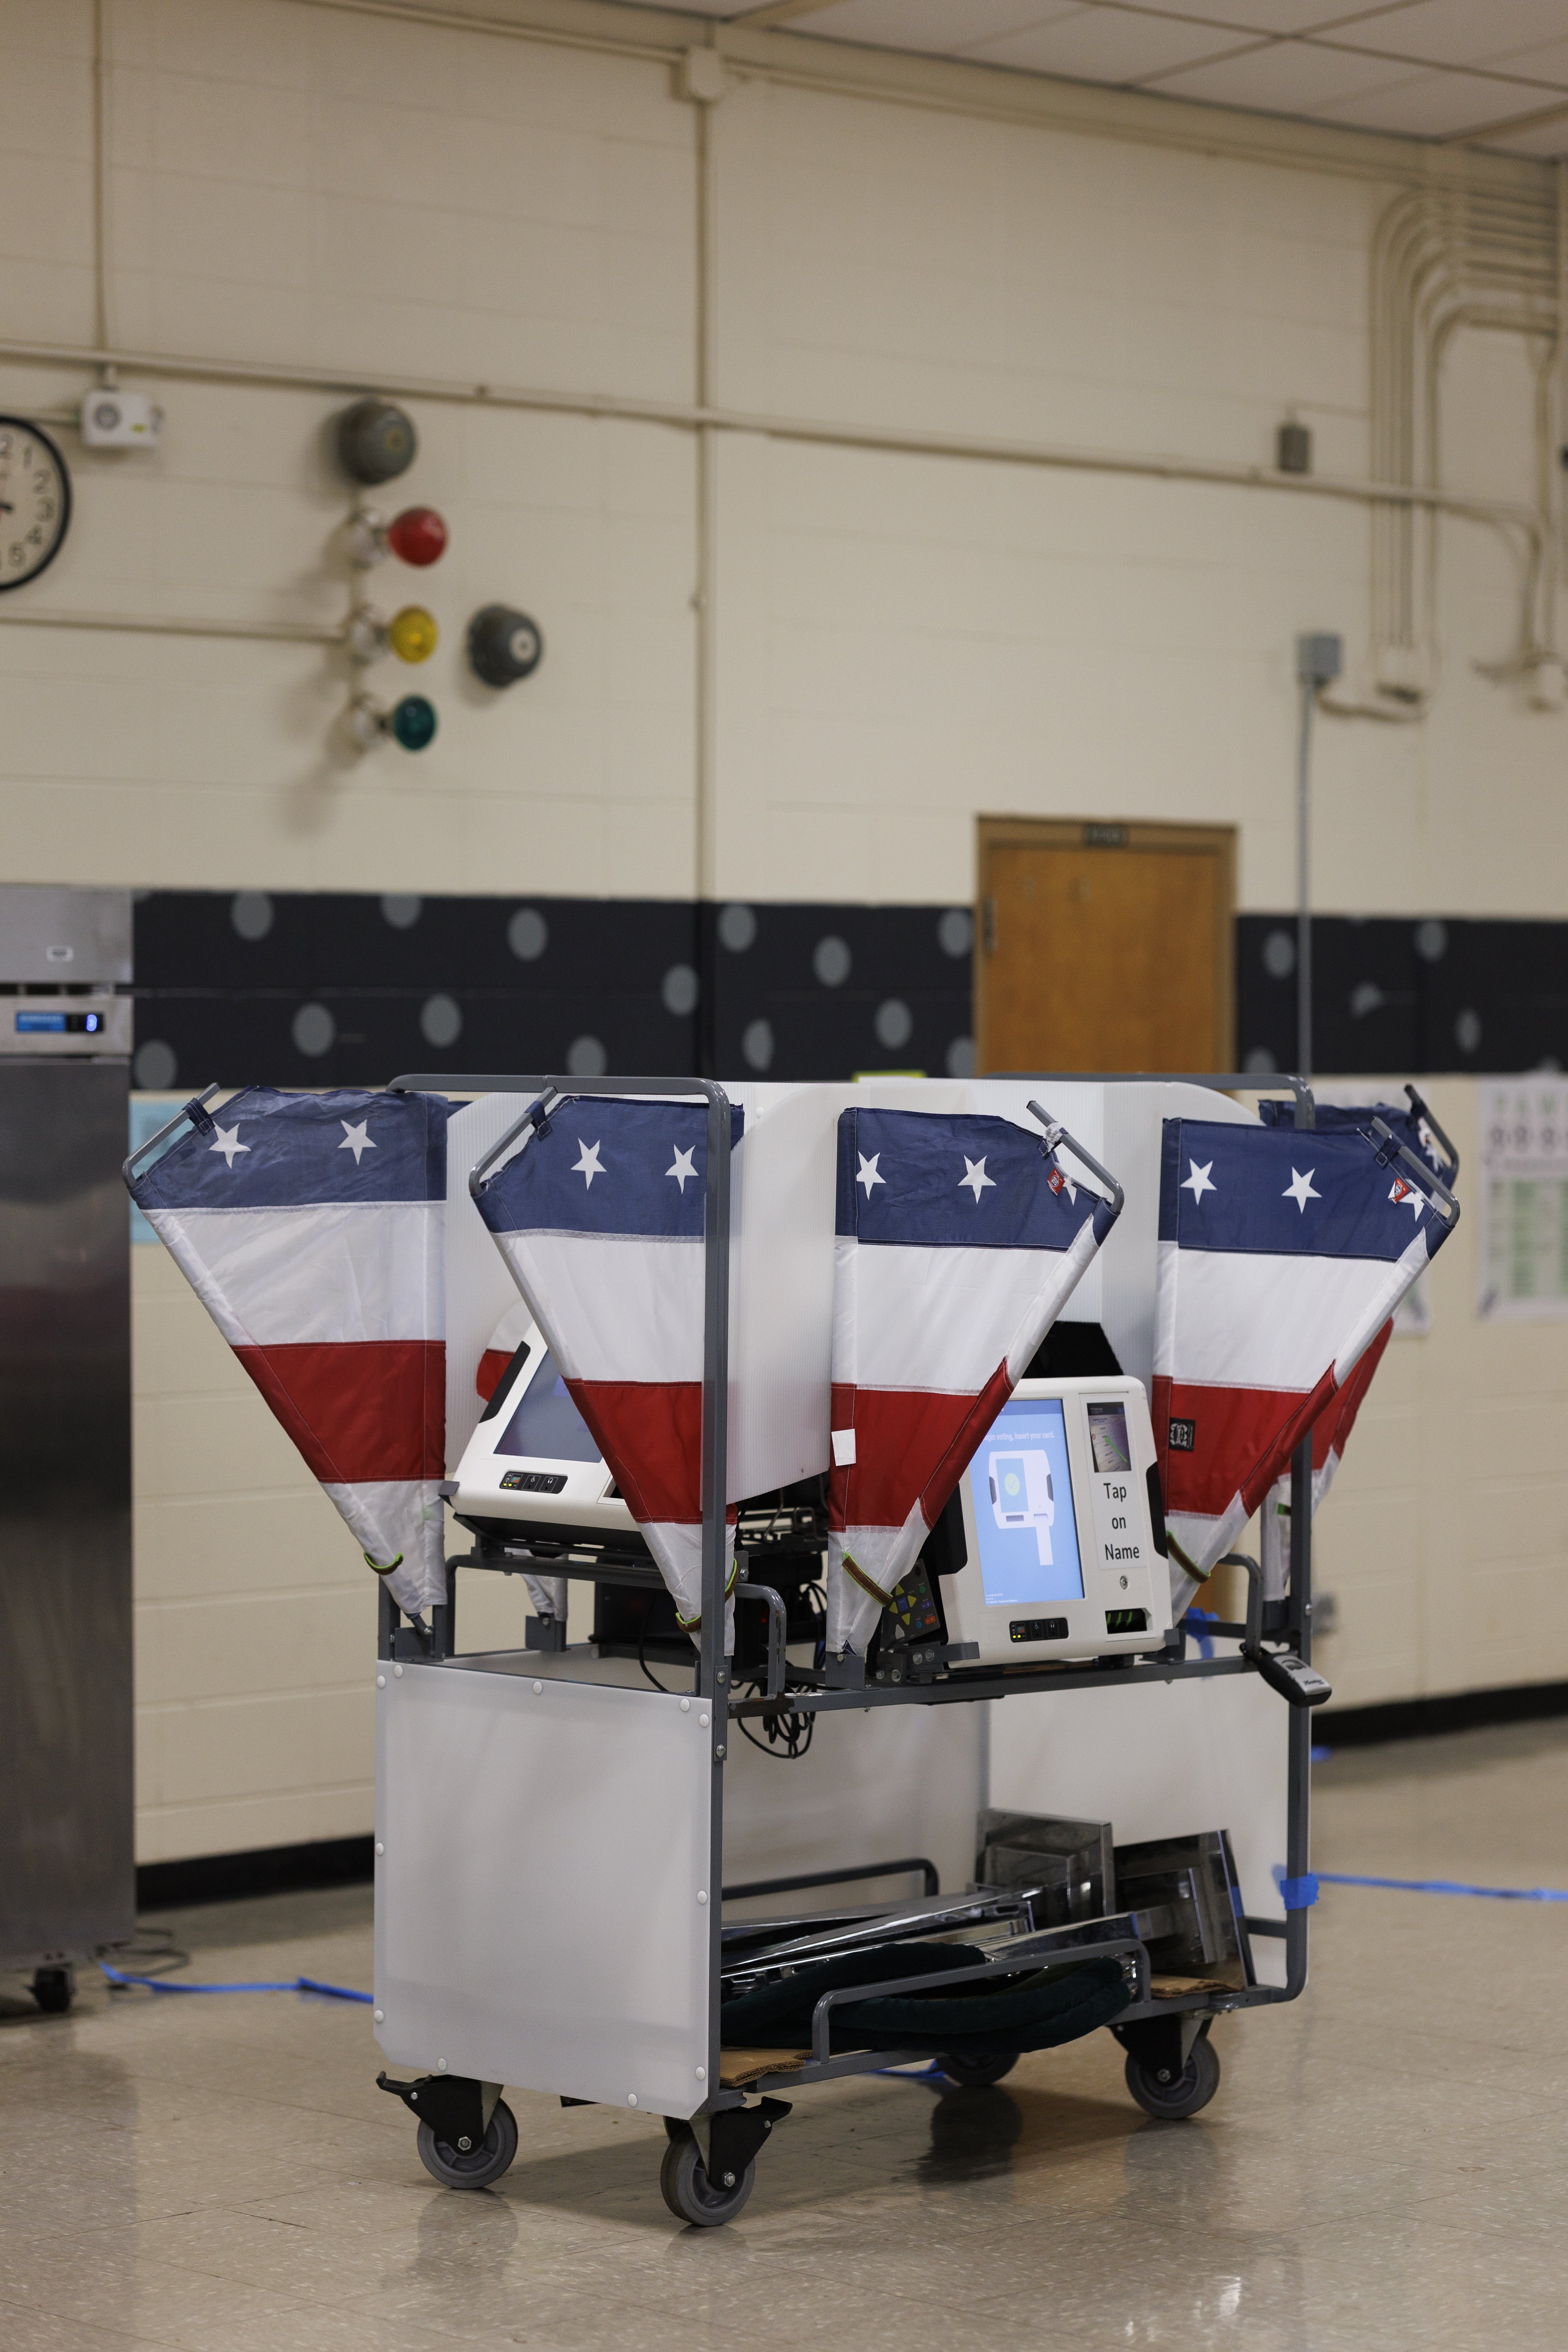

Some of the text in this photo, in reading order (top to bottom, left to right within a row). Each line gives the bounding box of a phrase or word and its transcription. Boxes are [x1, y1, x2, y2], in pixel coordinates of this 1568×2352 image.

[985, 1433, 996, 1442] egin
[997, 1433, 1014, 1441] voting,
[1103, 1483, 1127, 1502] Tap
[1112, 1517, 1126, 1529] on
[1105, 1544, 1140, 1560] Name
